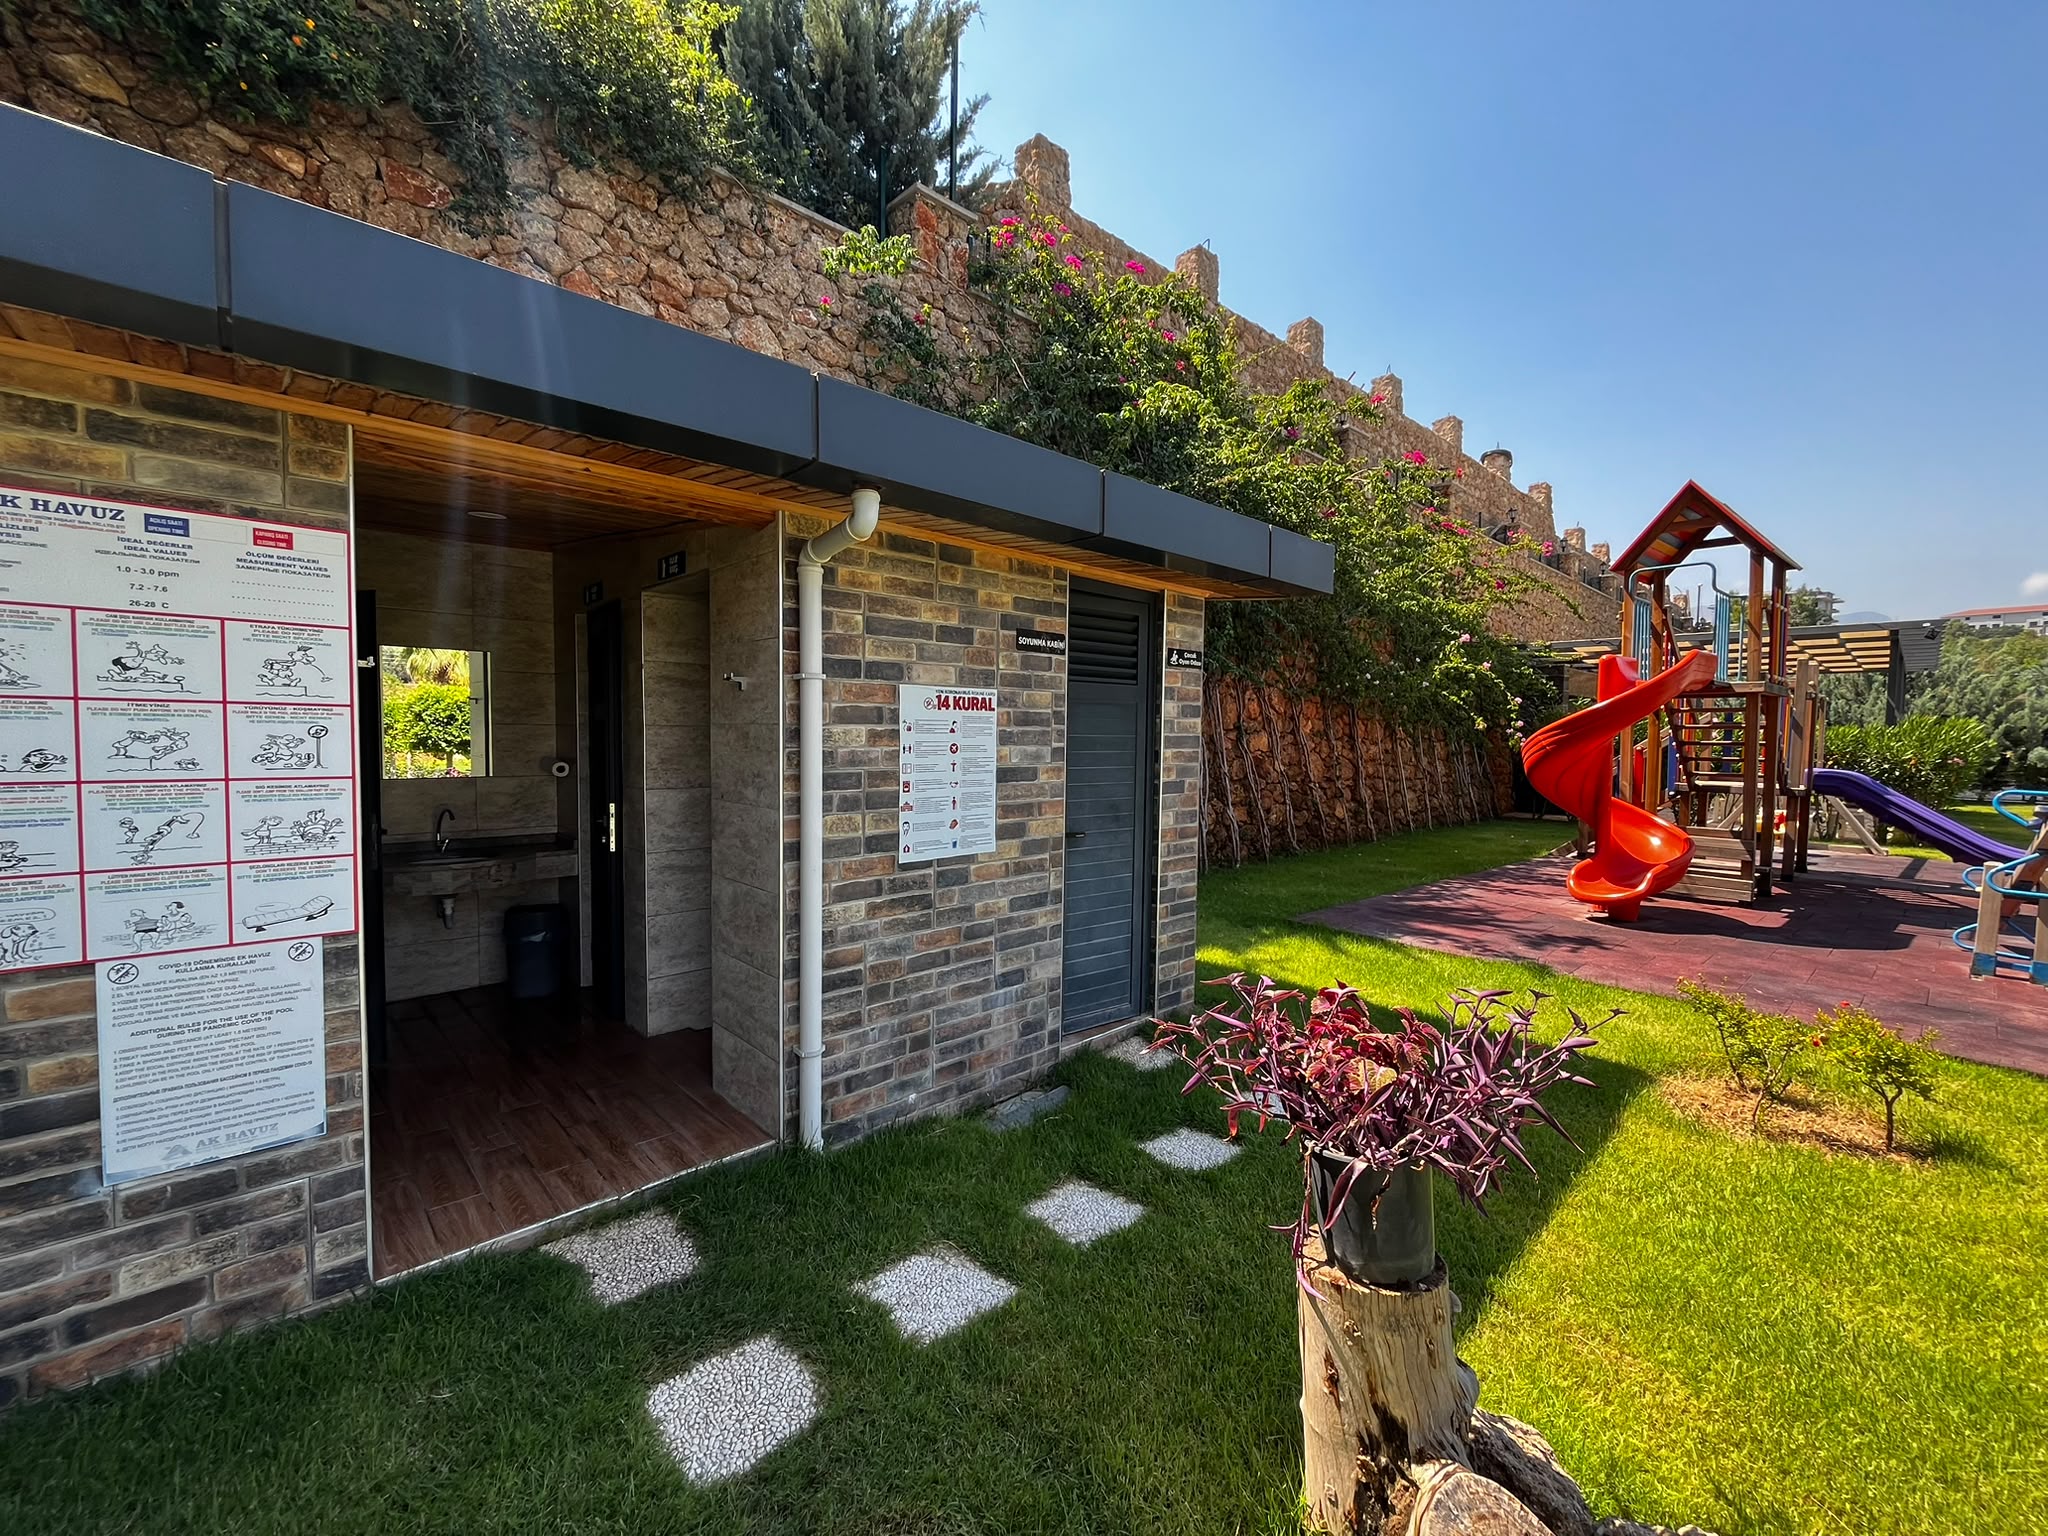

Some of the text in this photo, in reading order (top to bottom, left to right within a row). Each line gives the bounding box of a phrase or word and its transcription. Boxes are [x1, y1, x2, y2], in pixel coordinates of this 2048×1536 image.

[30, 498, 125, 521] HAVUZ
[117, 536, 193, 549] İDEAL DEĞERLER
[153, 548, 187, 556] VALUES
[246, 551, 319, 564] ÖLÇÜM DEĞERLERİ
[149, 555, 200, 564] ПОКАЗАТЕЛИ
[236, 558, 328, 572] MEASUREMENT VALUES
[117, 565, 131, 573] 1.0
[236, 564, 331, 578] ЗАМЕРНЫЕ ПОКАЗАТЕЛИ
[129, 600, 156, 608] 26-28
[1018, 636, 1065, 648] SOYUNMA KABİNİ
[936, 695, 995, 712] 14 KURAL
[158, 962, 191, 970] COVID-19
[194, 956, 236, 966] DÖNEMİNDE
[175, 960, 256, 974] KULLANMA KURALLARI
[130, 1026, 175, 1037] ADDITIONAL
[177, 1022, 201, 1030] RULES
[157, 1030, 185, 1039] DURING
[203, 1022, 239, 1031] PANDEMIC
[241, 1017, 271, 1025] COVID-19
[173, 1037, 201, 1045] DISTANCE
[196, 1136, 220, 1148] AK
[226, 1122, 279, 1141] HAVUZ
